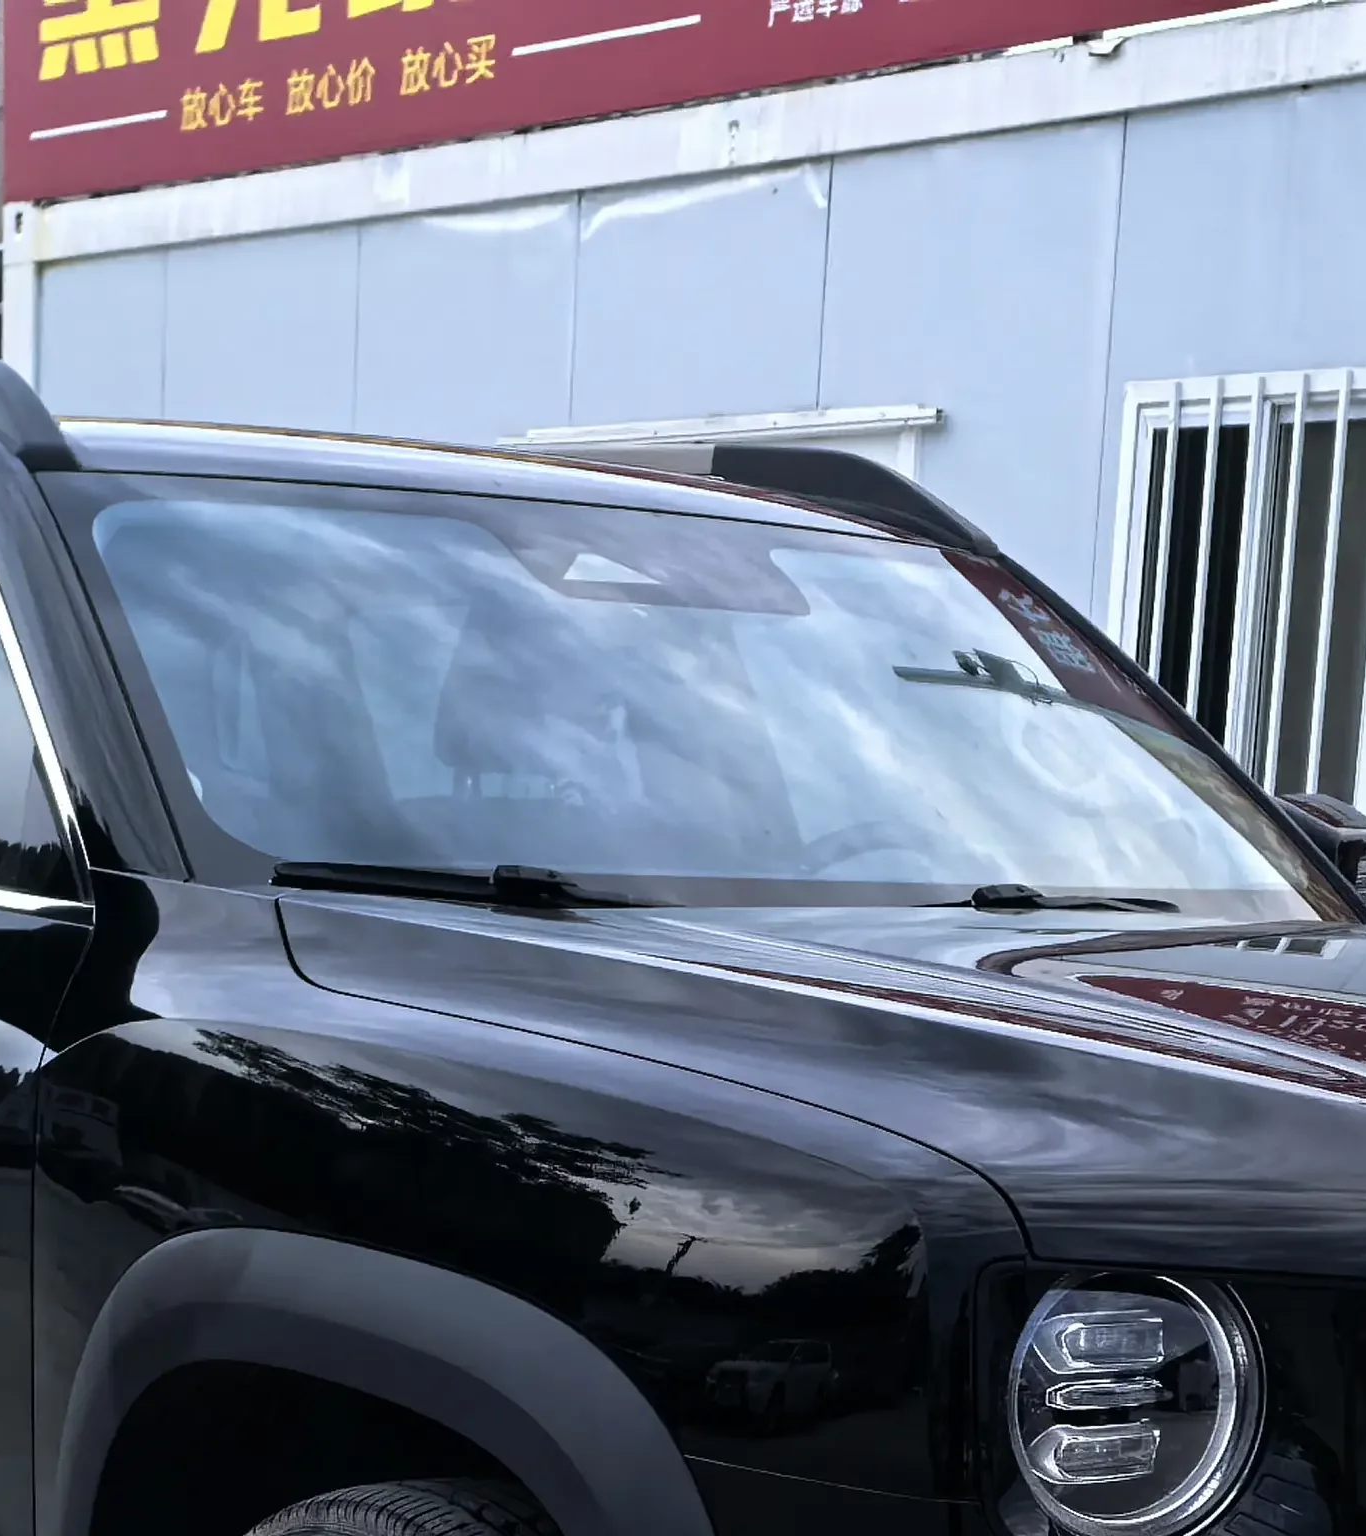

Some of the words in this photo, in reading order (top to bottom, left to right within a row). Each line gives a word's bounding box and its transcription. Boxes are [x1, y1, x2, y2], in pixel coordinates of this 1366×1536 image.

[180, 78, 265, 132] 放心车
[285, 55, 377, 116] 放心价
[399, 33, 497, 96] 放心买
